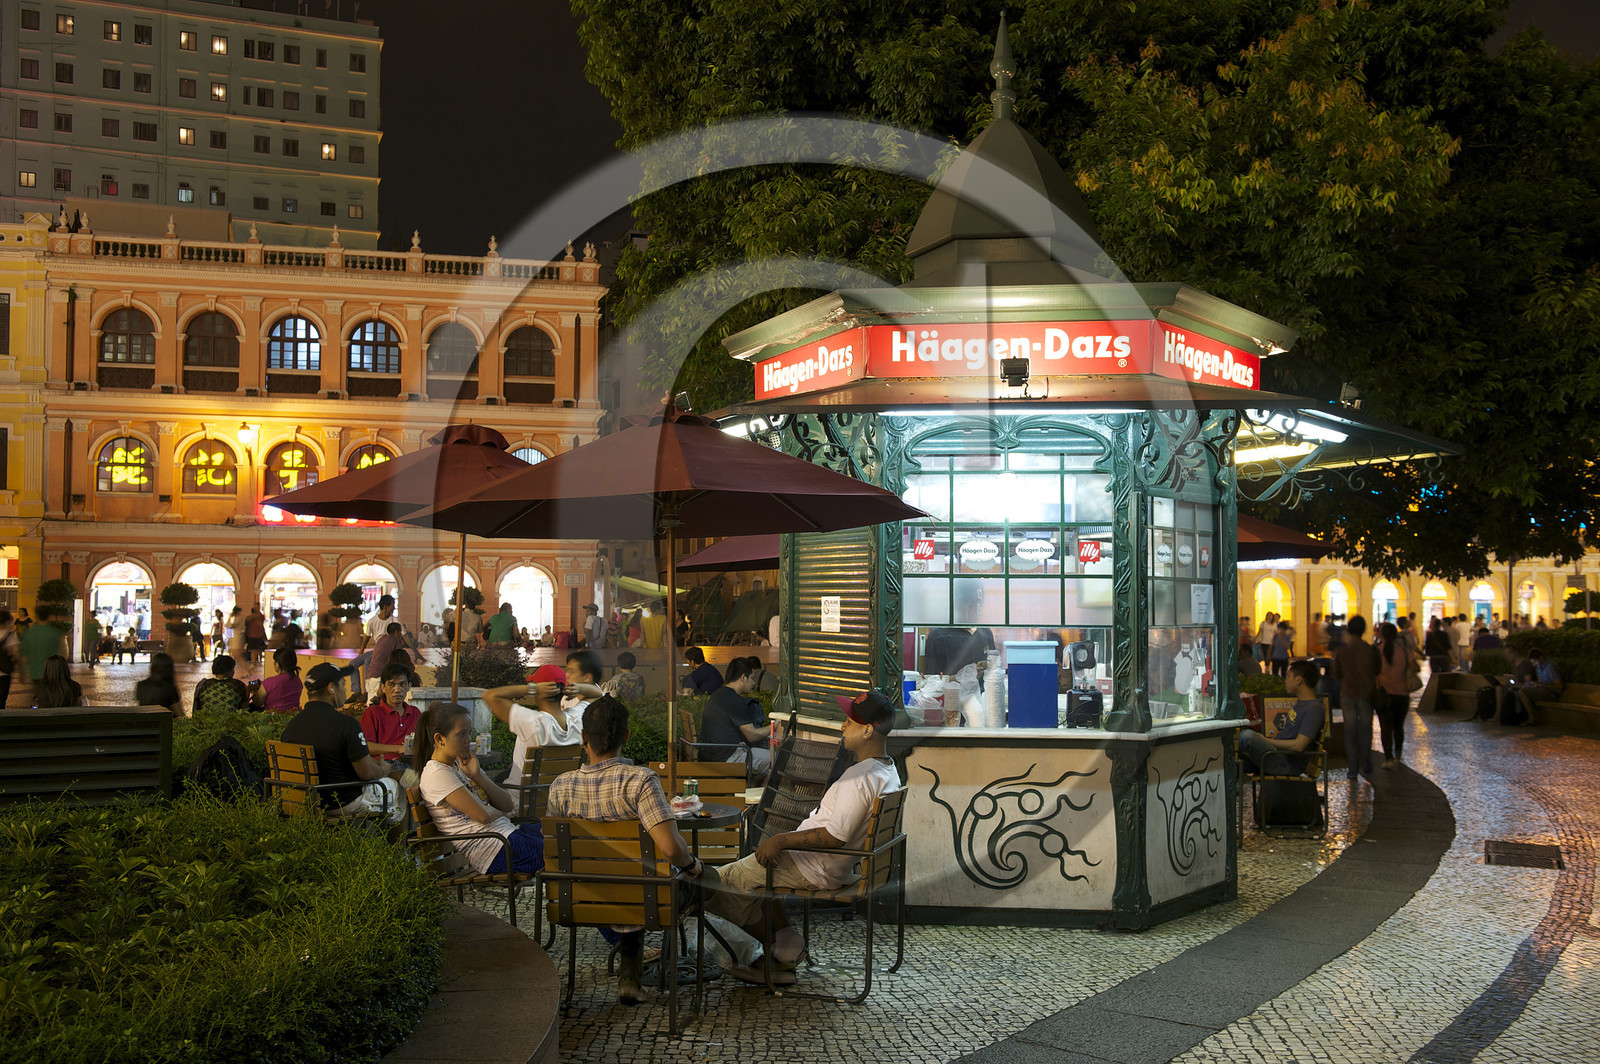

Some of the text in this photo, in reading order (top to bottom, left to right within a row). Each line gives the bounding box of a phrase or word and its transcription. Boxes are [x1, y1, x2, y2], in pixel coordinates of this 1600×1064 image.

[763, 344, 853, 393] Häagen-Dazs
[892, 328, 1131, 370] Häagen-Dazs
[1164, 330, 1254, 388] Häagen-Dazs
[915, 541, 933, 559] illy
[1080, 543, 1099, 560] illy
